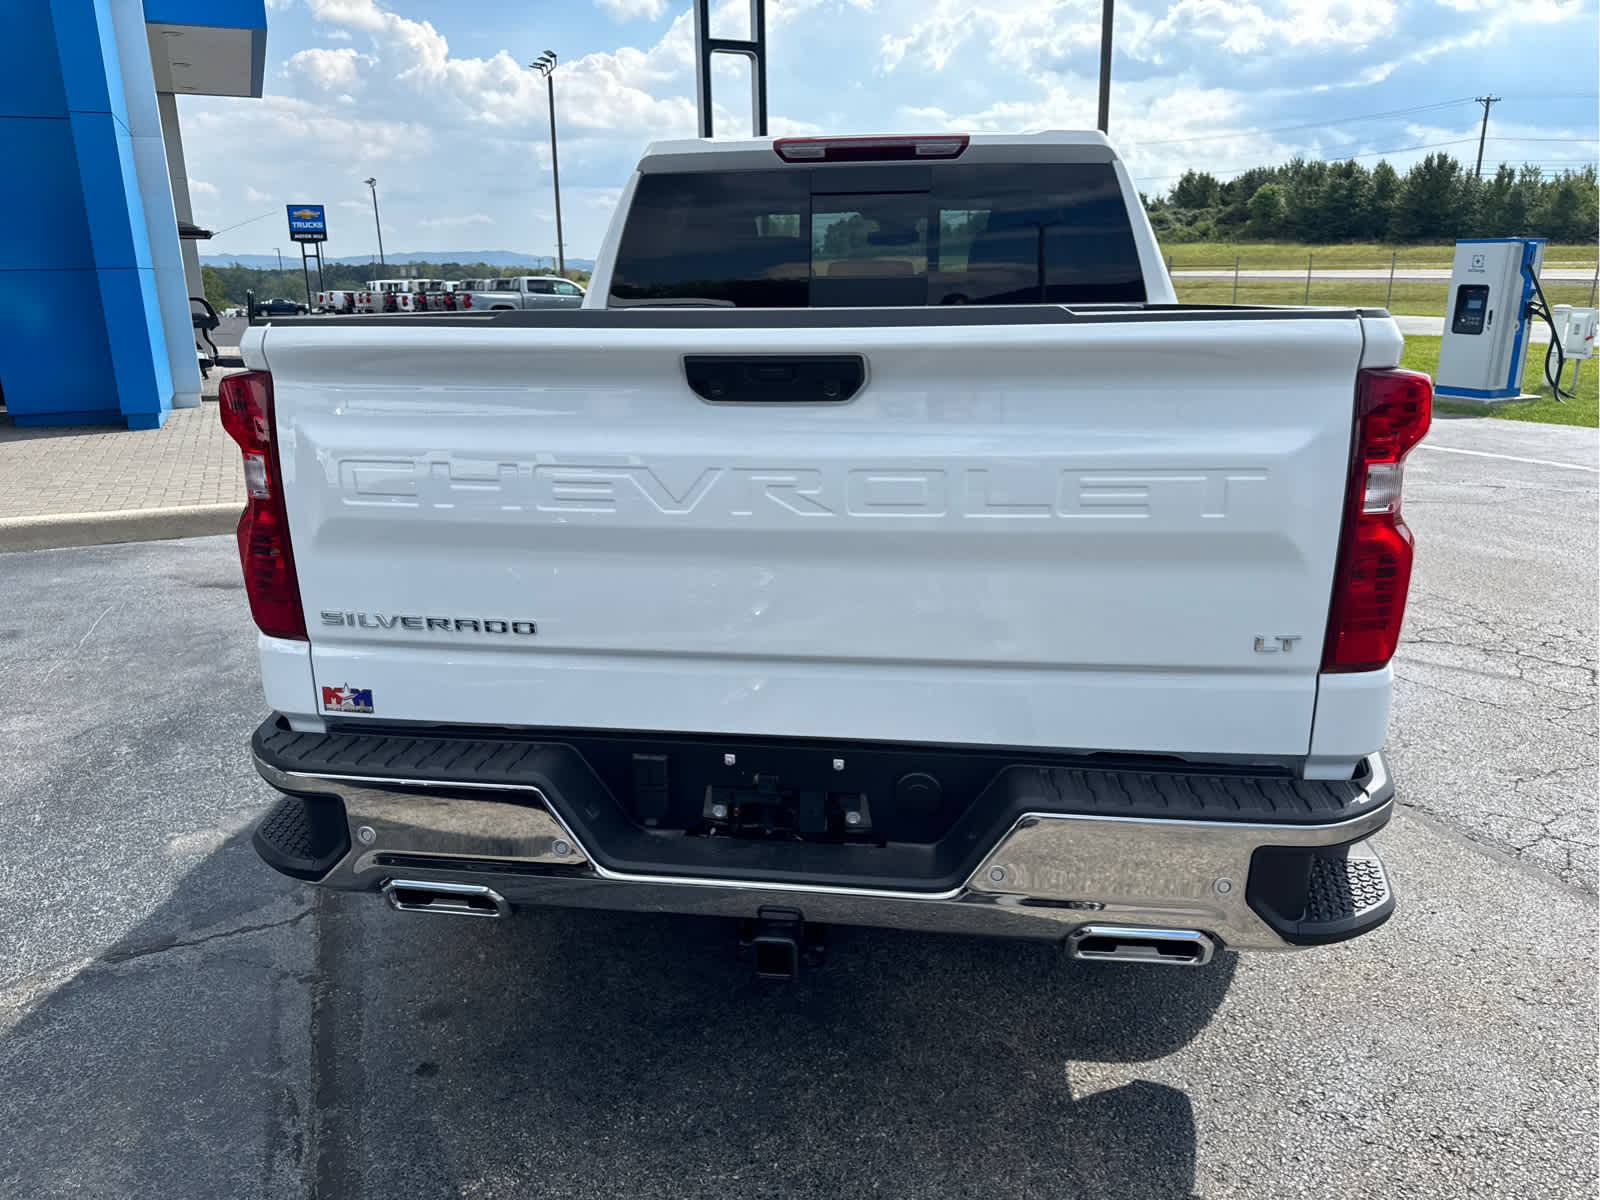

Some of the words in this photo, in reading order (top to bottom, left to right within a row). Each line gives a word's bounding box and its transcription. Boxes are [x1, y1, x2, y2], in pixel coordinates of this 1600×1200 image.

[292, 221, 323, 229] TRUCKS
[338, 457, 1269, 520] CHEVROLET
[319, 609, 538, 636] SILVERADO
[1254, 633, 1304, 653] LT
